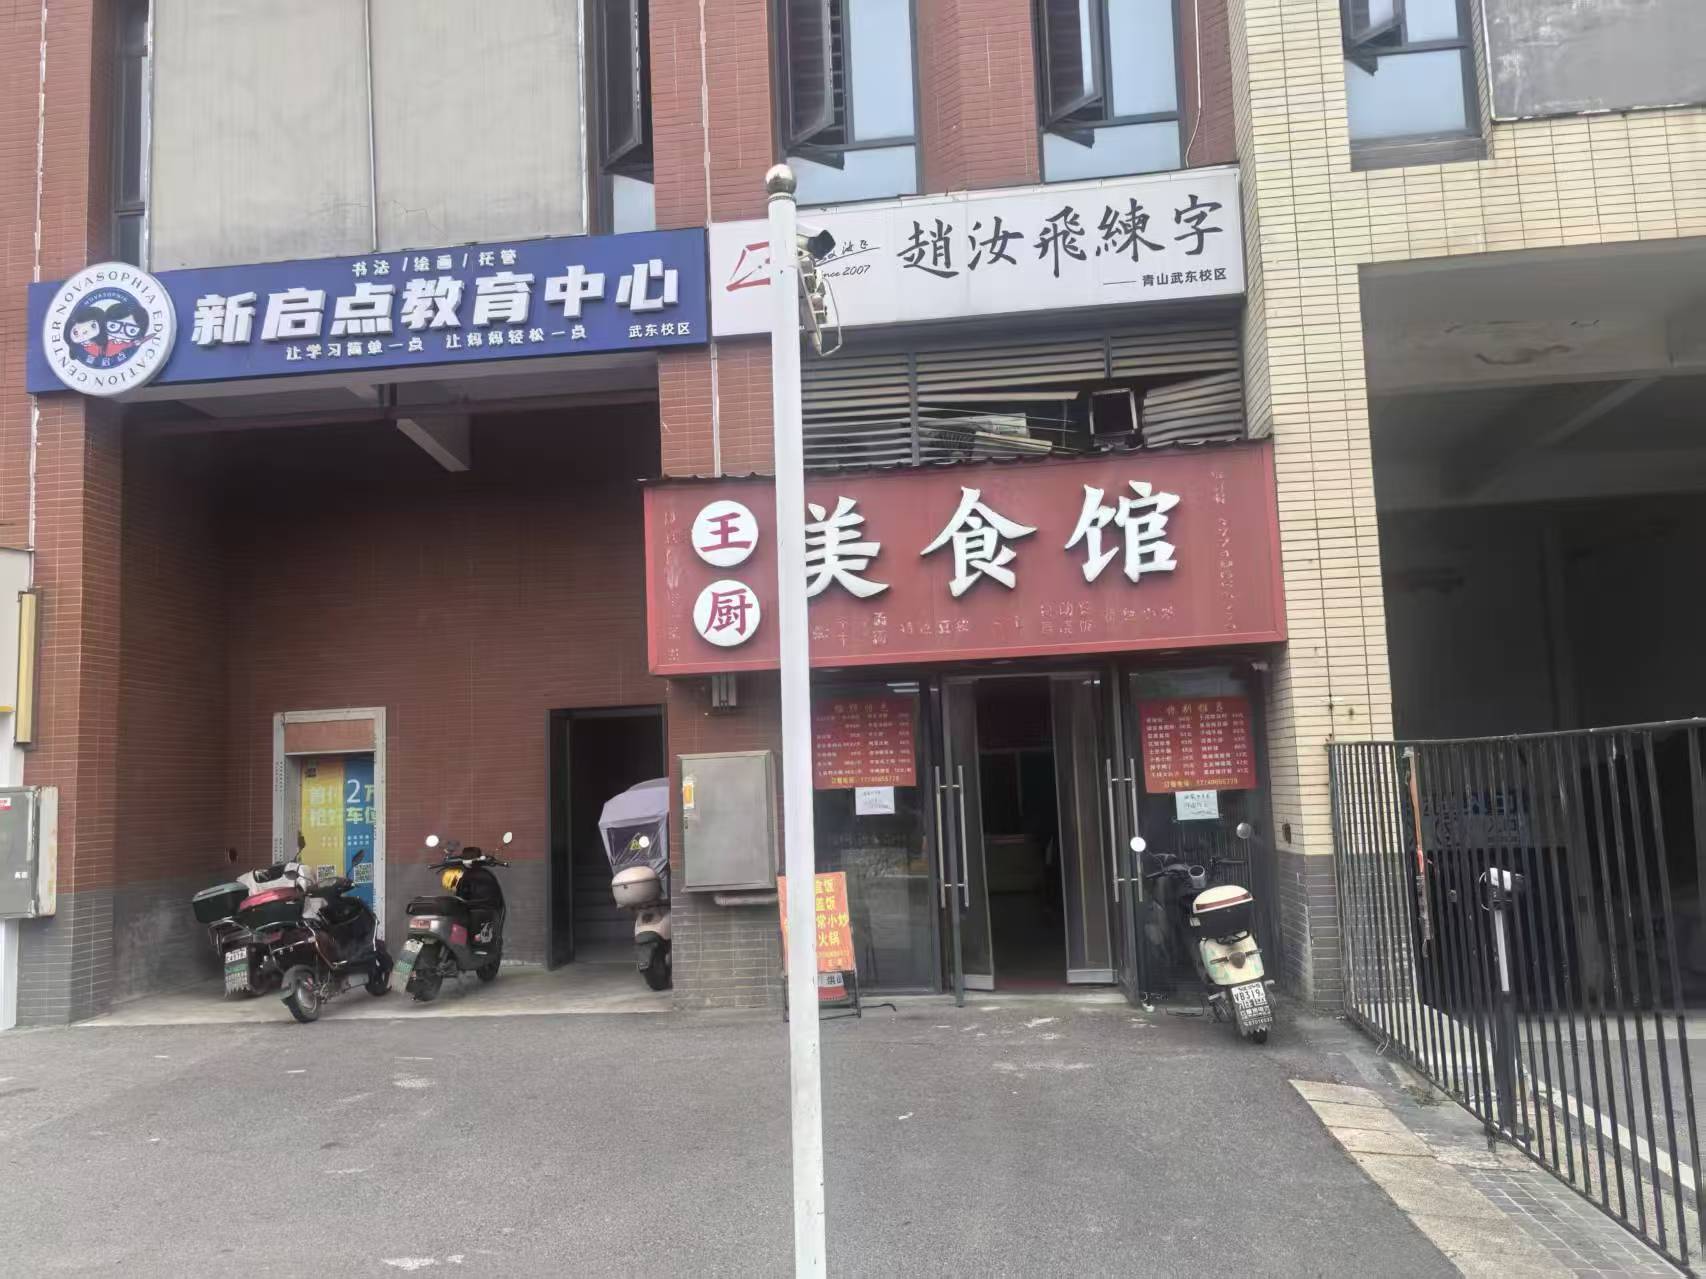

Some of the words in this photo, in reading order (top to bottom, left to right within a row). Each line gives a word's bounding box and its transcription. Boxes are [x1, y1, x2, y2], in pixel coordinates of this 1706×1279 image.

[897, 195, 1224, 279] 趙汝飛練字
[56, 271, 156, 314] NOVASOPHIA
[842, 264, 871, 276] 2007
[1142, 268, 1227, 287] 青山武东校区
[191, 258, 678, 345] 新启点教育中心
[52, 320, 88, 382] CENTER
[95, 310, 163, 387] EDUCATION
[286, 336, 424, 360] 让学习简单一点
[446, 324, 587, 350] 让妈妈轻松一点
[629, 321, 690, 340] 武东校区
[804, 480, 1181, 599] 美食馆
